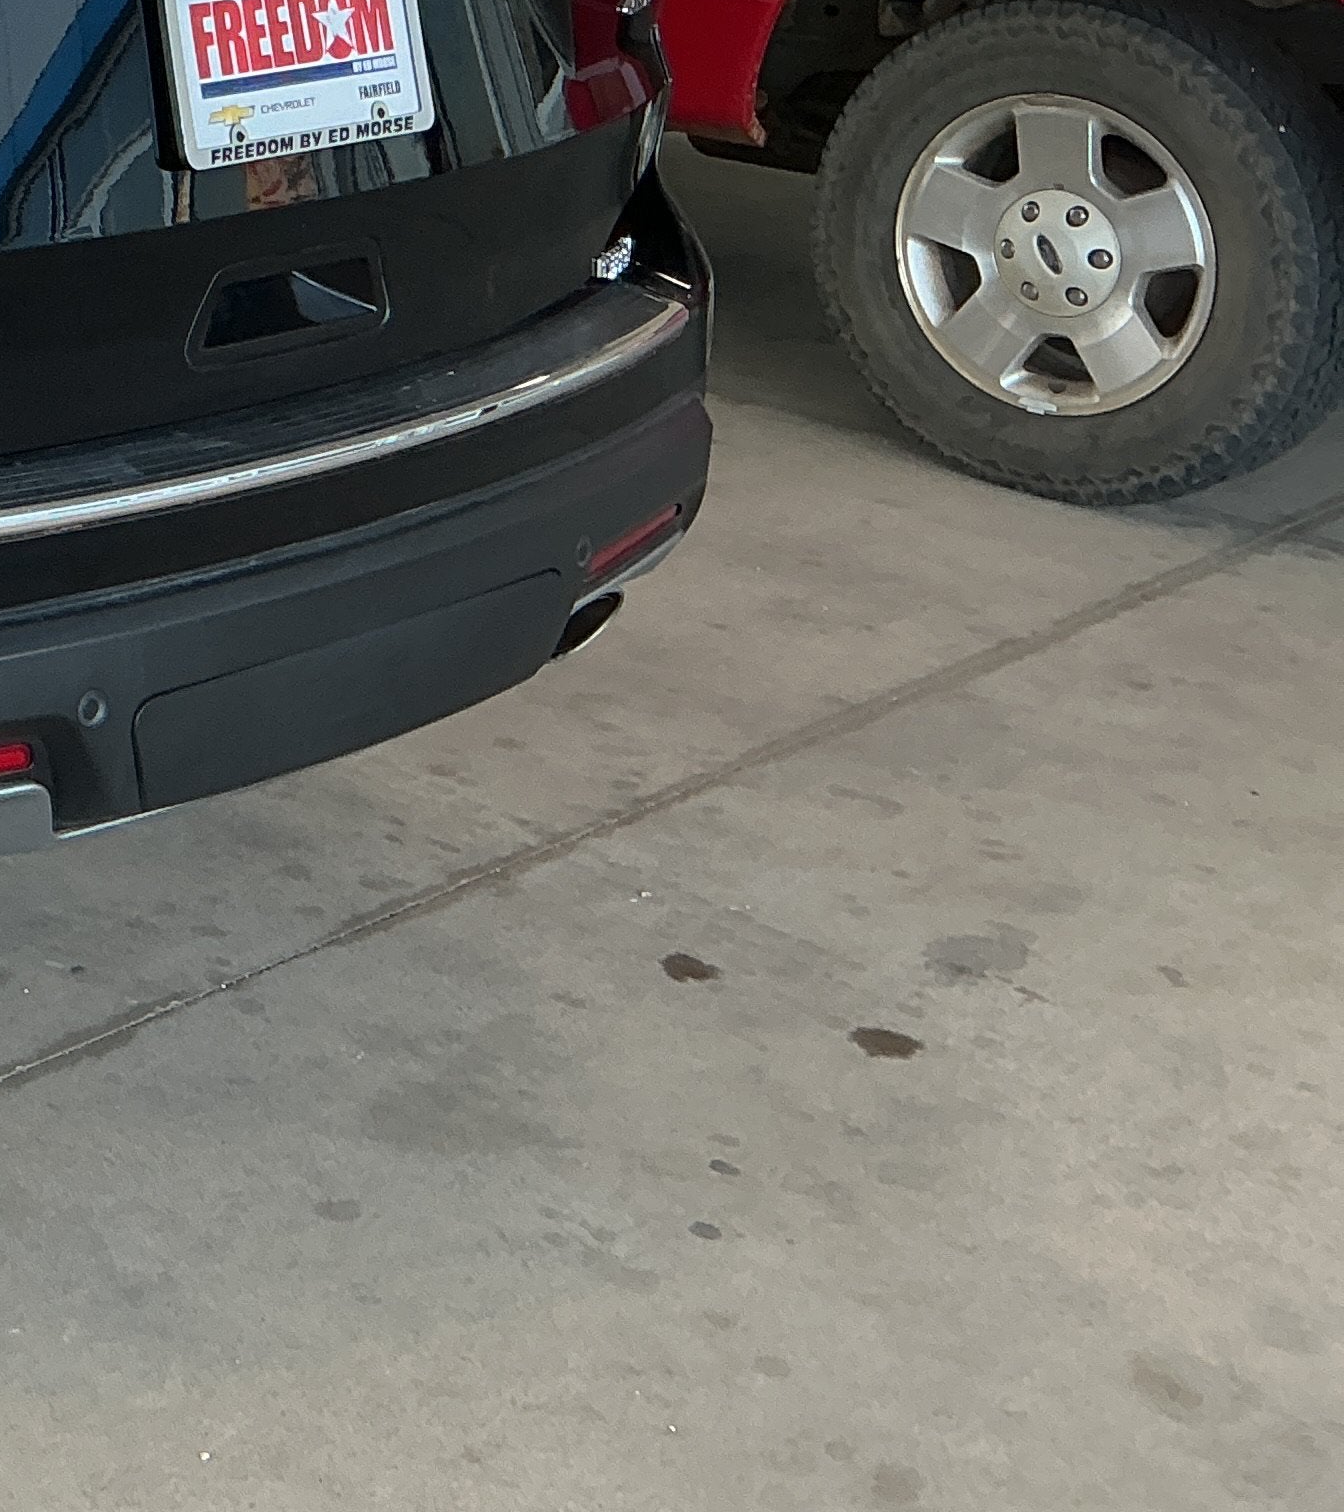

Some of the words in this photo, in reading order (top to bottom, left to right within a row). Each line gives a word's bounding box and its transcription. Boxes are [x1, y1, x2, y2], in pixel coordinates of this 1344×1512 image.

[358, 80, 402, 100] FAIRFIELD
[260, 97, 316, 114] CHEVROLET
[211, 137, 294, 165] FREEDOM
[299, 131, 322, 150] BY
[327, 126, 350, 144] ED
[356, 115, 414, 139] MORSE
